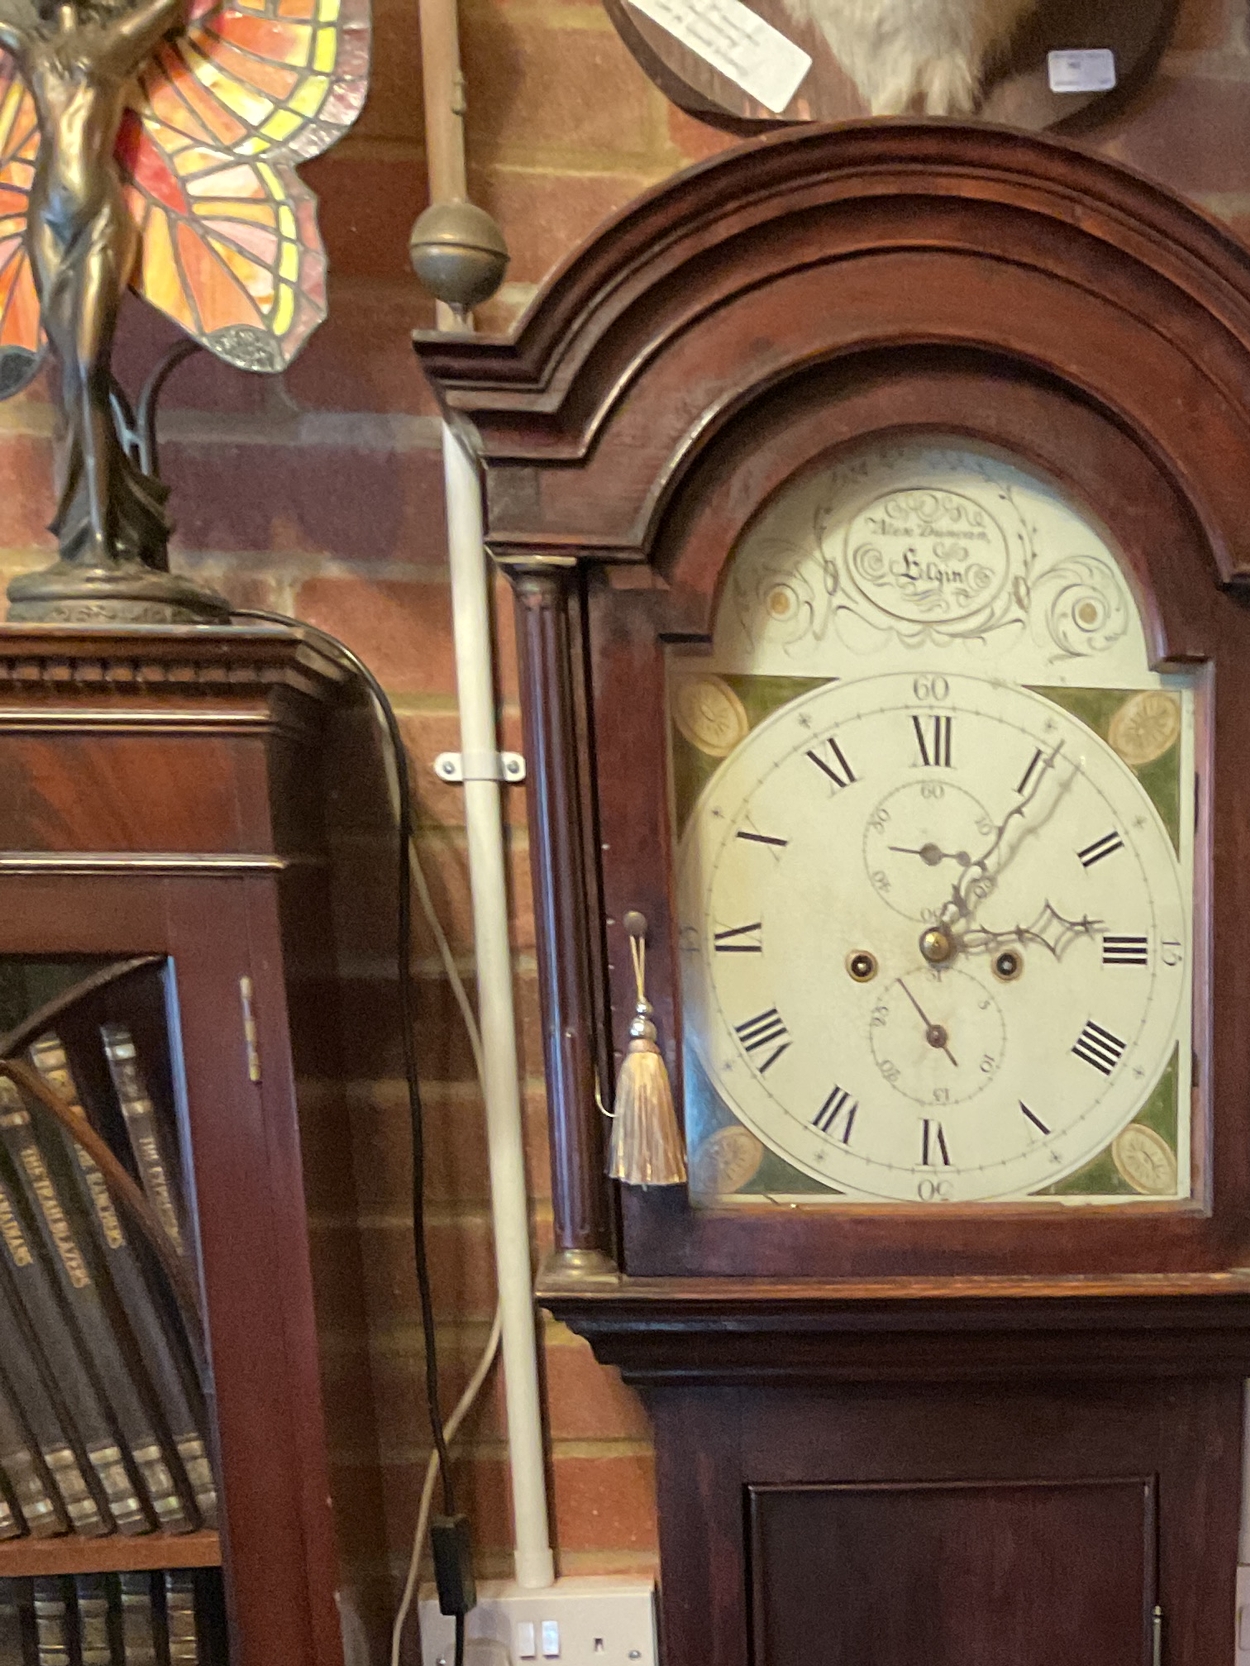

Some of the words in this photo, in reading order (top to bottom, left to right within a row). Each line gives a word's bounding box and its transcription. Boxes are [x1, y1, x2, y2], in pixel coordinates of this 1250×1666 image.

[913, 675, 950, 701] 60
[909, 714, 957, 768] XII
[806, 736, 863, 798] XI
[920, 783, 946, 800] 60
[1076, 826, 1126, 876] II
[1101, 933, 1149, 968] III
[1160, 936, 1183, 967] 15
[733, 1004, 794, 1078] VIII
[809, 1083, 859, 1147] VII
[915, 1116, 953, 1168] VI
